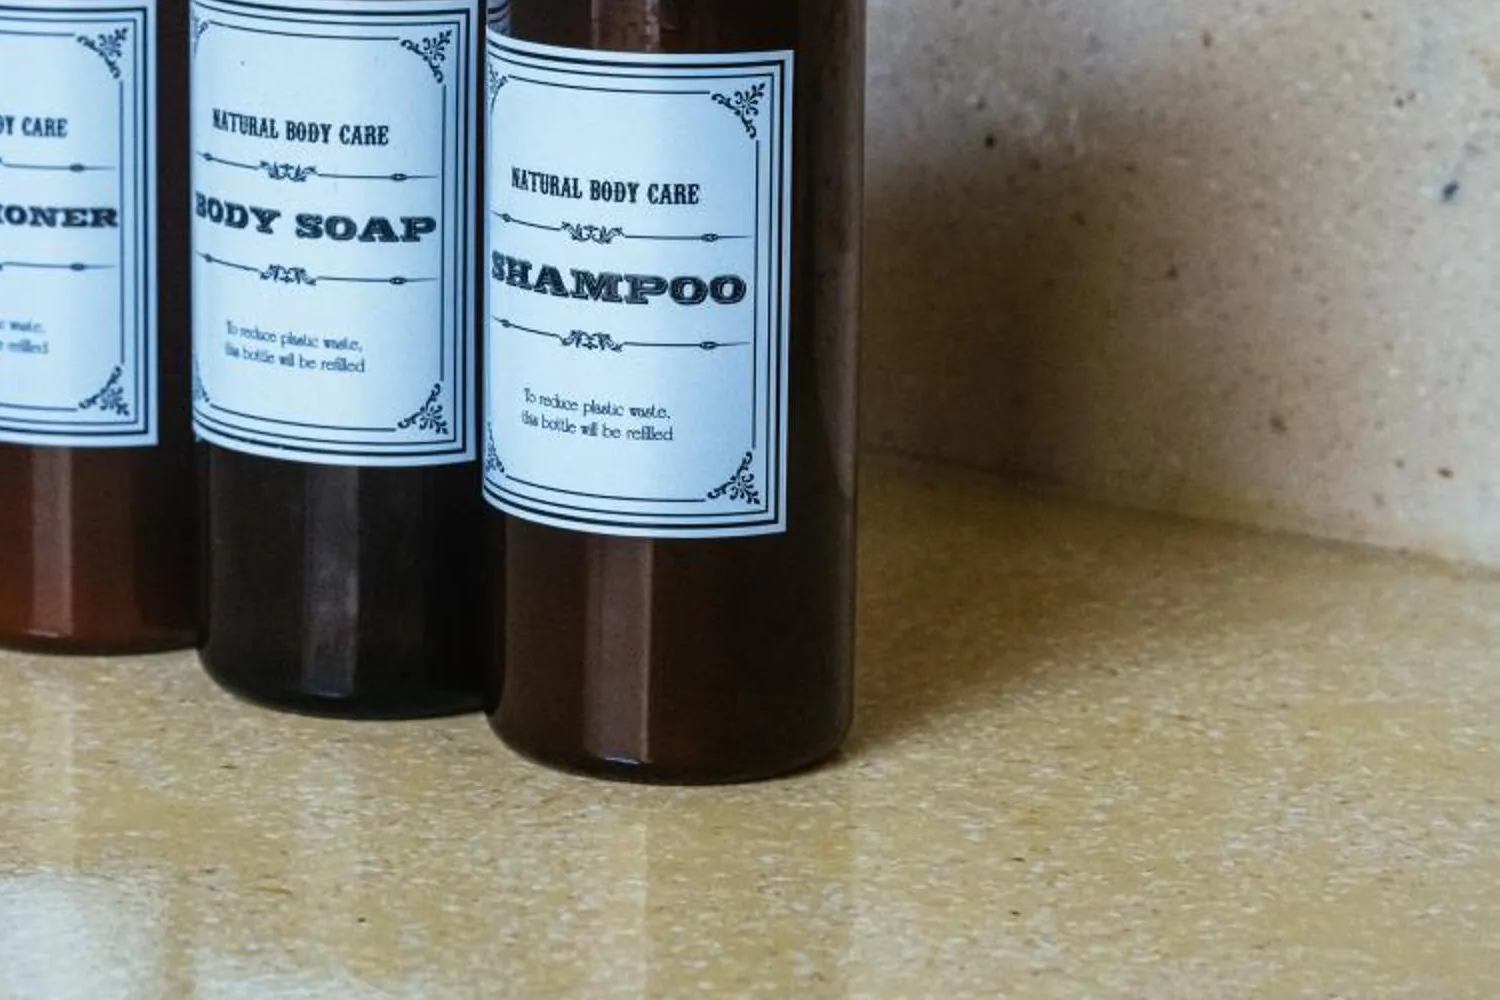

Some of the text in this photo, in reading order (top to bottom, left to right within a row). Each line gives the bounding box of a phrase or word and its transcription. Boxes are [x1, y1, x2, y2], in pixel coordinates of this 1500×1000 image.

[21, 117, 69, 138] CARE
[212, 107, 390, 146] NATURAL BODY CARE
[511, 166, 700, 205] NATURAL BODY CARE
[195, 190, 437, 243] BODY SOAP
[491, 250, 747, 305] SHAMPOO
[298, 353, 318, 369] be
[523, 387, 537, 404] To
[539, 393, 579, 411] reduce
[583, 399, 625, 416] plastic
[541, 413, 577, 434] bottle
[580, 420, 598, 437] will
[602, 421, 622, 439] be
[626, 425, 673, 441] refilled
